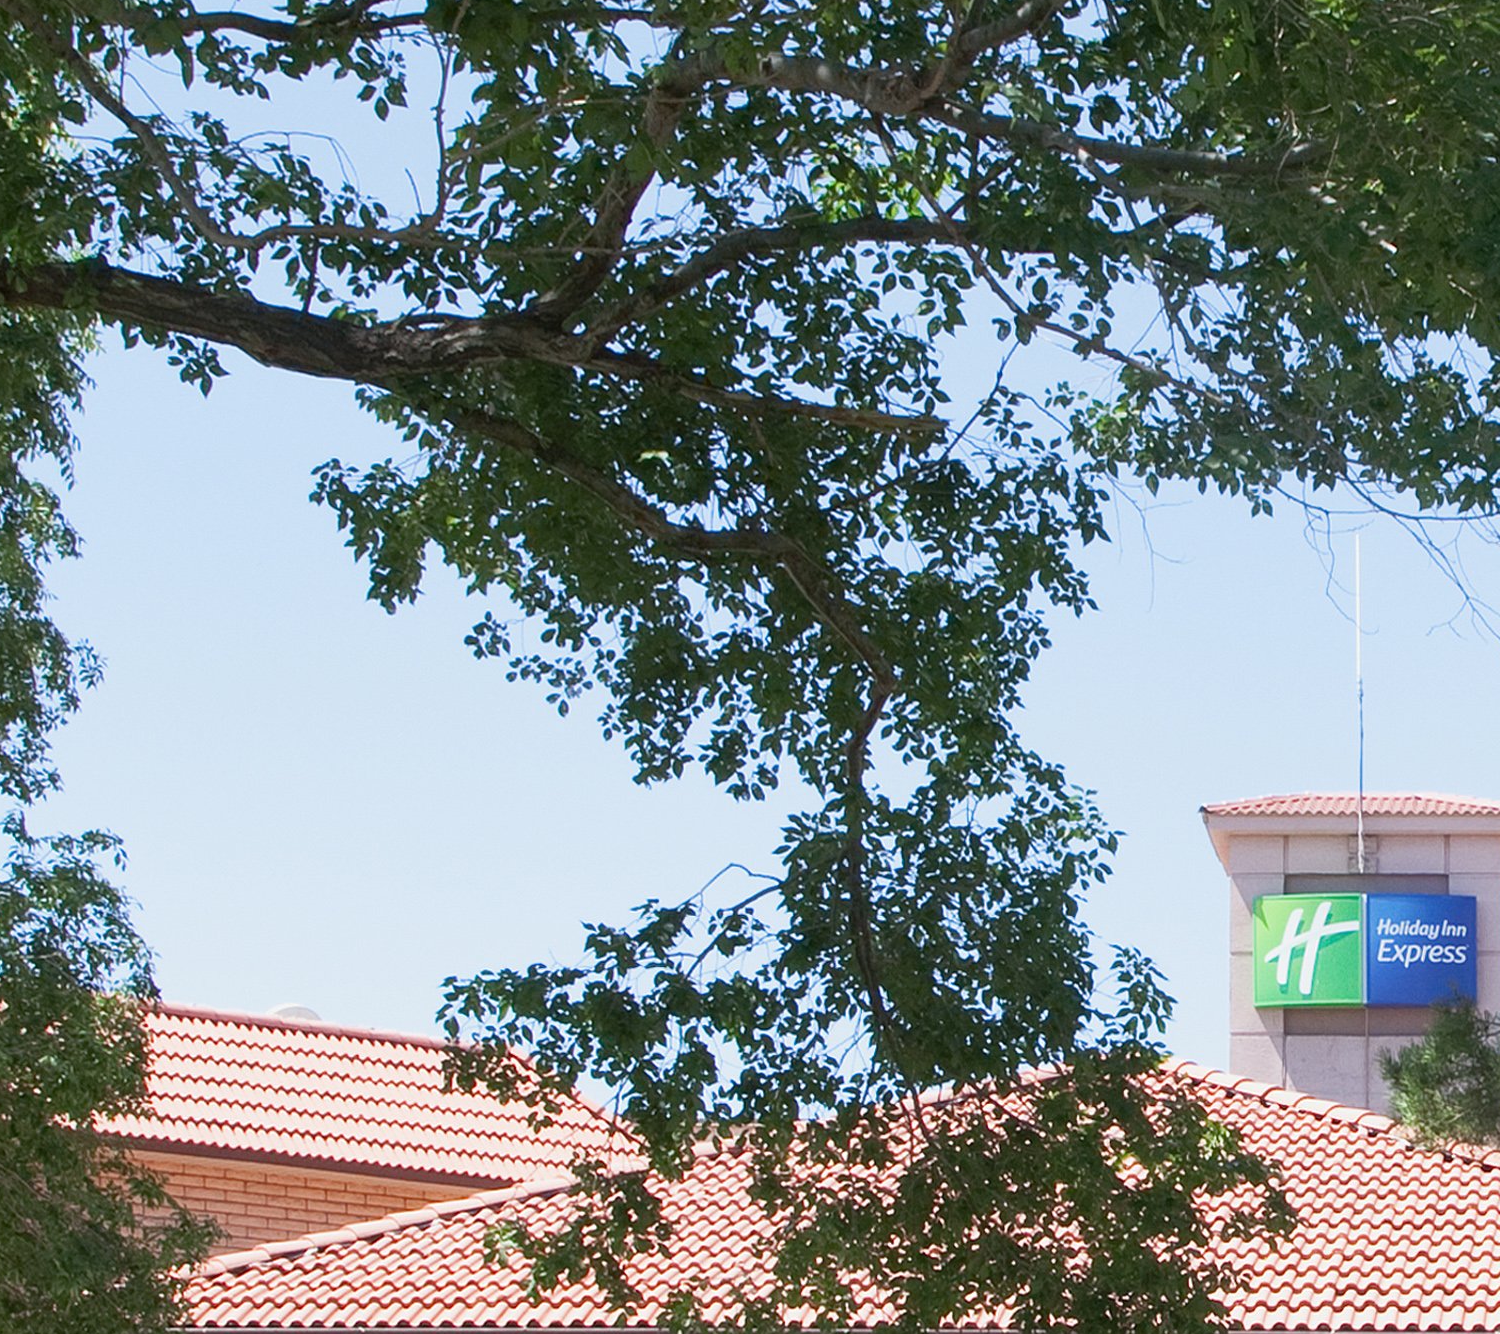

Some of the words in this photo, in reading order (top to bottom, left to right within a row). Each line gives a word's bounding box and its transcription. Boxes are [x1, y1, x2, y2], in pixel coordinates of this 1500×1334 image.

[1376, 918, 1440, 940] Holiday
[1441, 919, 1467, 937] Inn
[1377, 939, 1467, 968] Express
